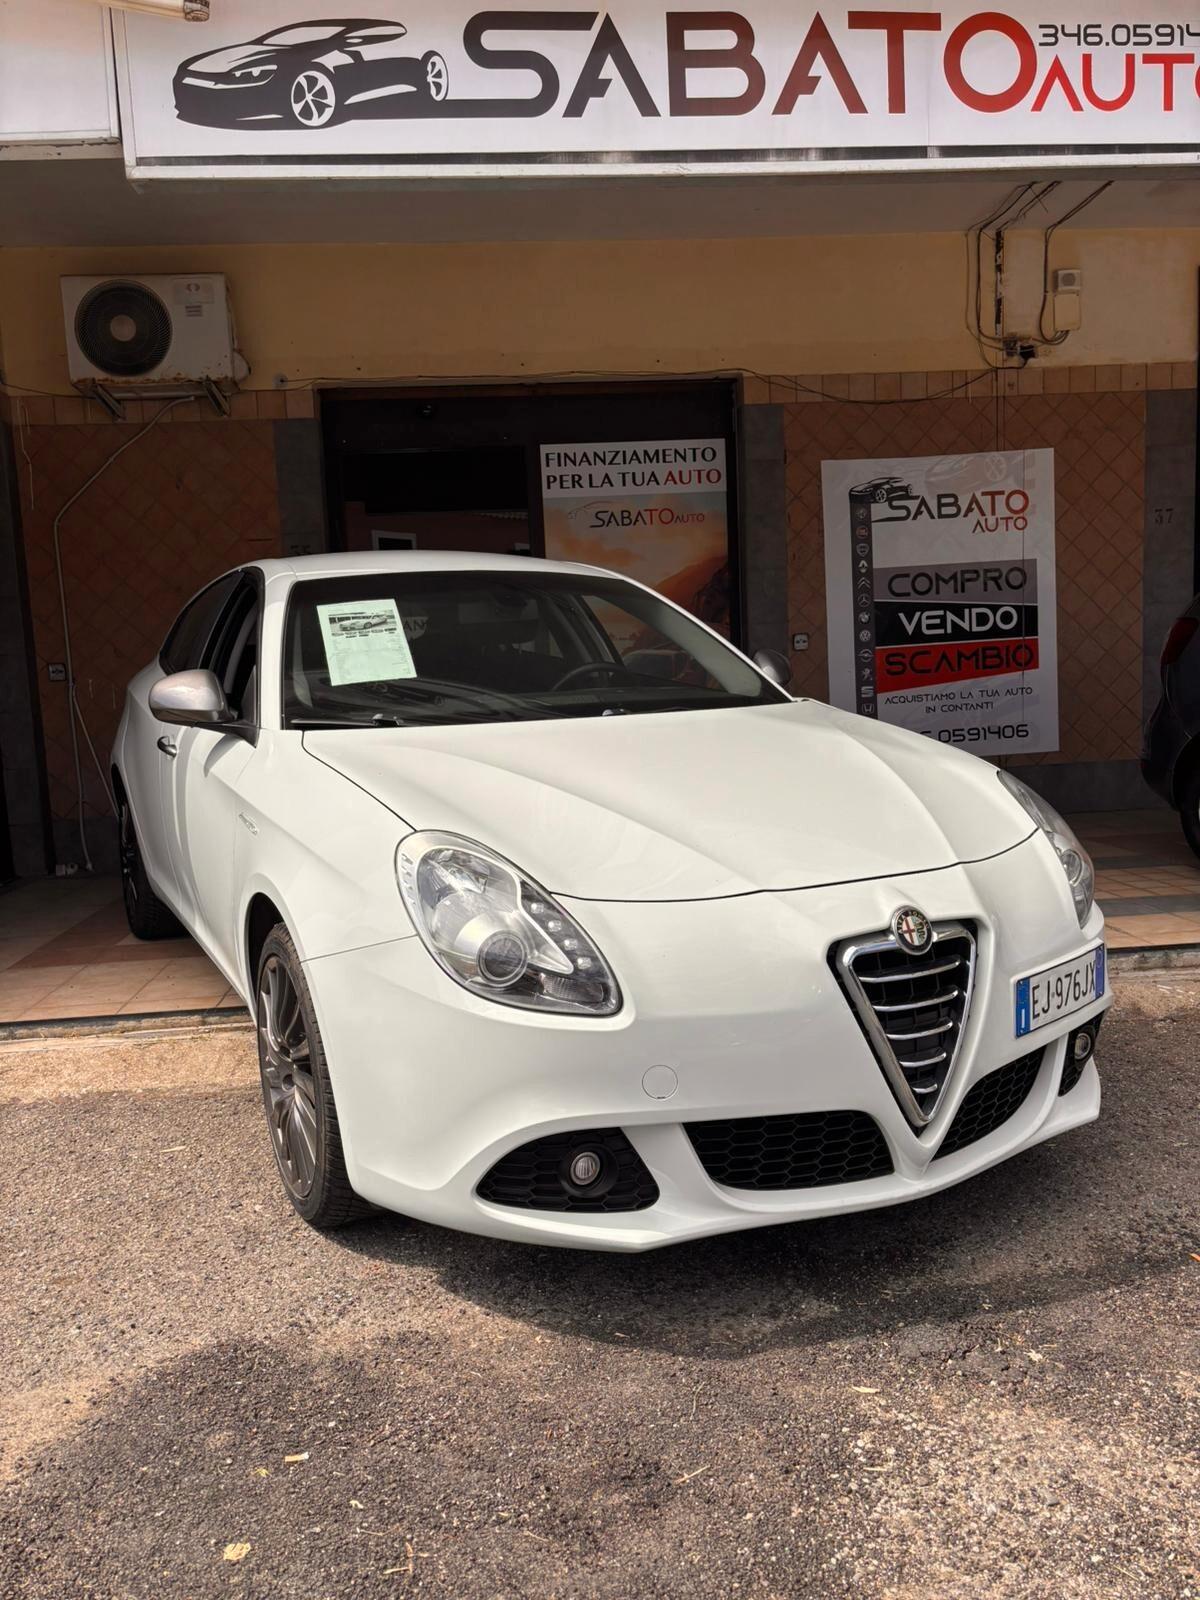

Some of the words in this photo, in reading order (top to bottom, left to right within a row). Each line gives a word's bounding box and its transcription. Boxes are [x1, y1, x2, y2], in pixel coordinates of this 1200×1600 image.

[461, 11, 1037, 117] SABATO
[1031, 53, 1200, 112] AUT
[545, 446, 717, 468] FINANZIAMENTO
[546, 473, 584, 490] PER
[588, 472, 614, 489] LA
[617, 471, 660, 487] TUA
[663, 468, 722, 486] AUTO
[873, 489, 1030, 523] SABATO
[589, 508, 675, 528] SABATO
[674, 513, 705, 524] AUTO
[971, 516, 1029, 534] AUTO
[887, 566, 1028, 598] COMPRO
[898, 605, 1019, 636] VENDO
[884, 643, 1034, 677] SCAMBIO
[884, 691, 956, 705] ACQUISTIAMO
[960, 690, 974, 700] LA
[978, 688, 1001, 698] TUA
[1004, 686, 1033, 697] AUTO
[925, 704, 936, 714] IN
[941, 701, 994, 714] CONTANTI
[920, 723, 1030, 744] 0591406
